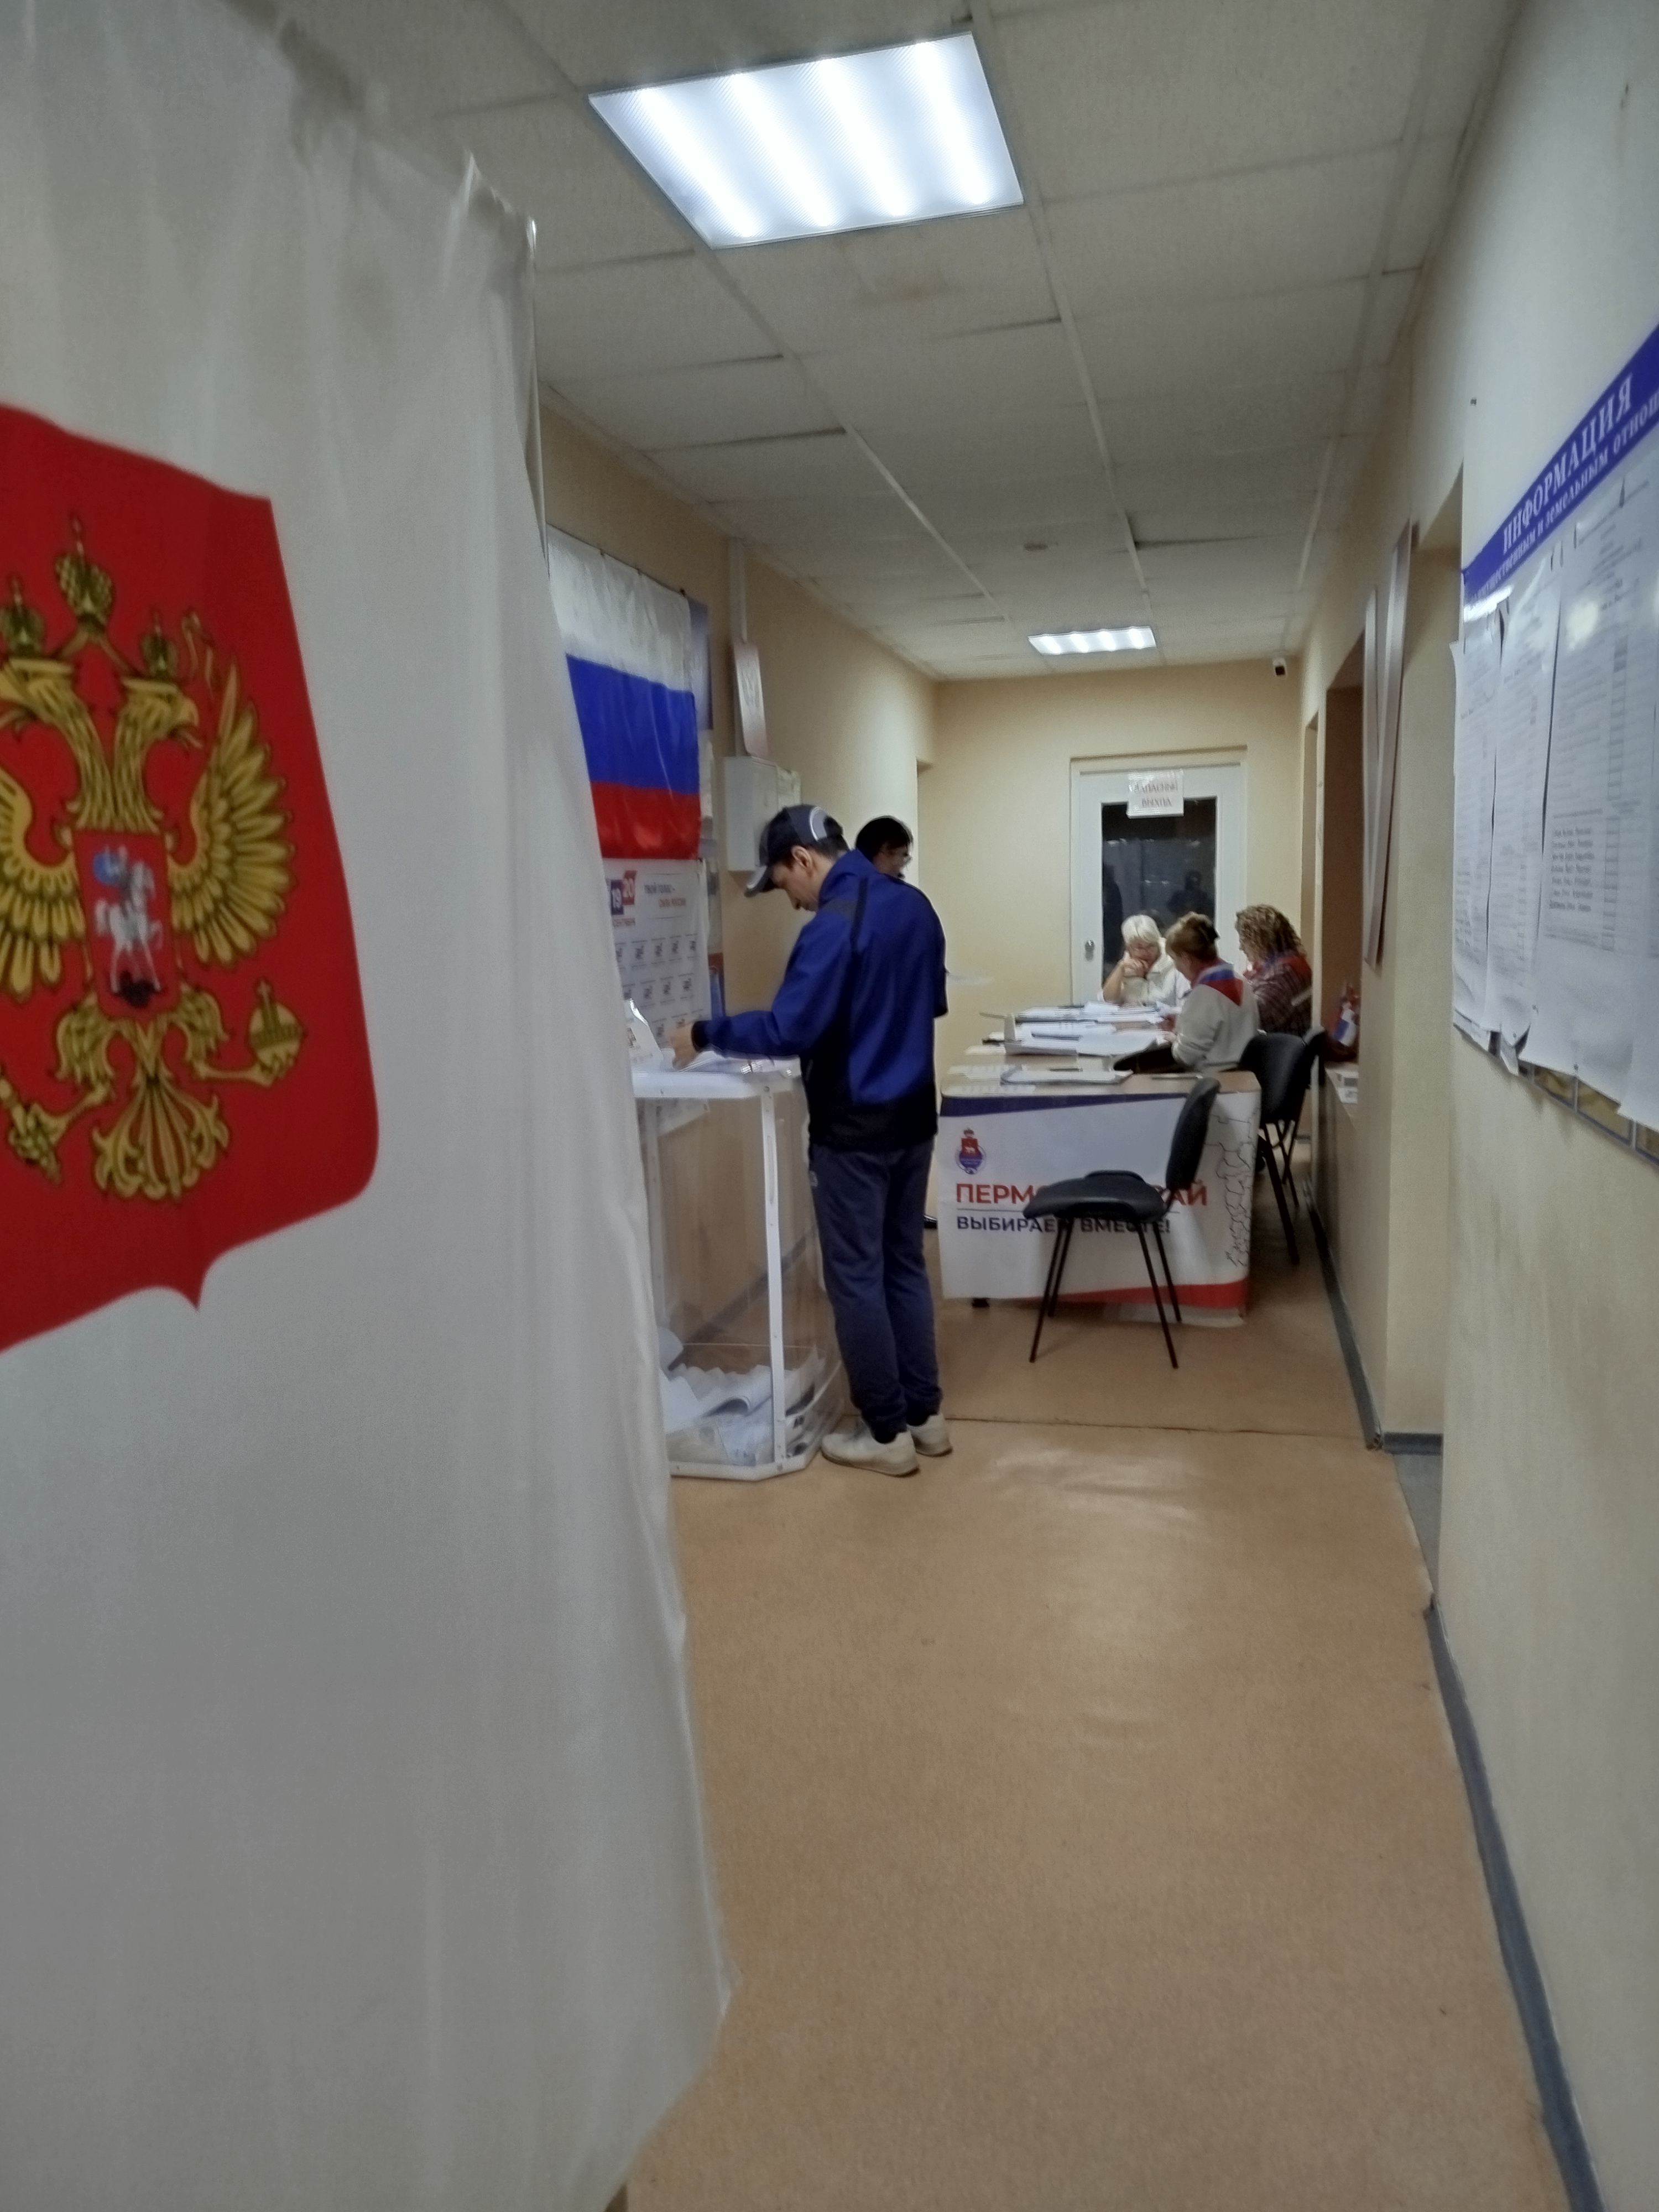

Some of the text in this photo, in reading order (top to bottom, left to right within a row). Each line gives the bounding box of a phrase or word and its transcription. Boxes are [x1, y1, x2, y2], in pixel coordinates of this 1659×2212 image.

[1503, 373, 1632, 555] ИНФОРМАЦИЯ
[956, 1183, 1042, 1204] ПЕРМ
[957, 1216, 1057, 1233] ВЫБИРАЕ
